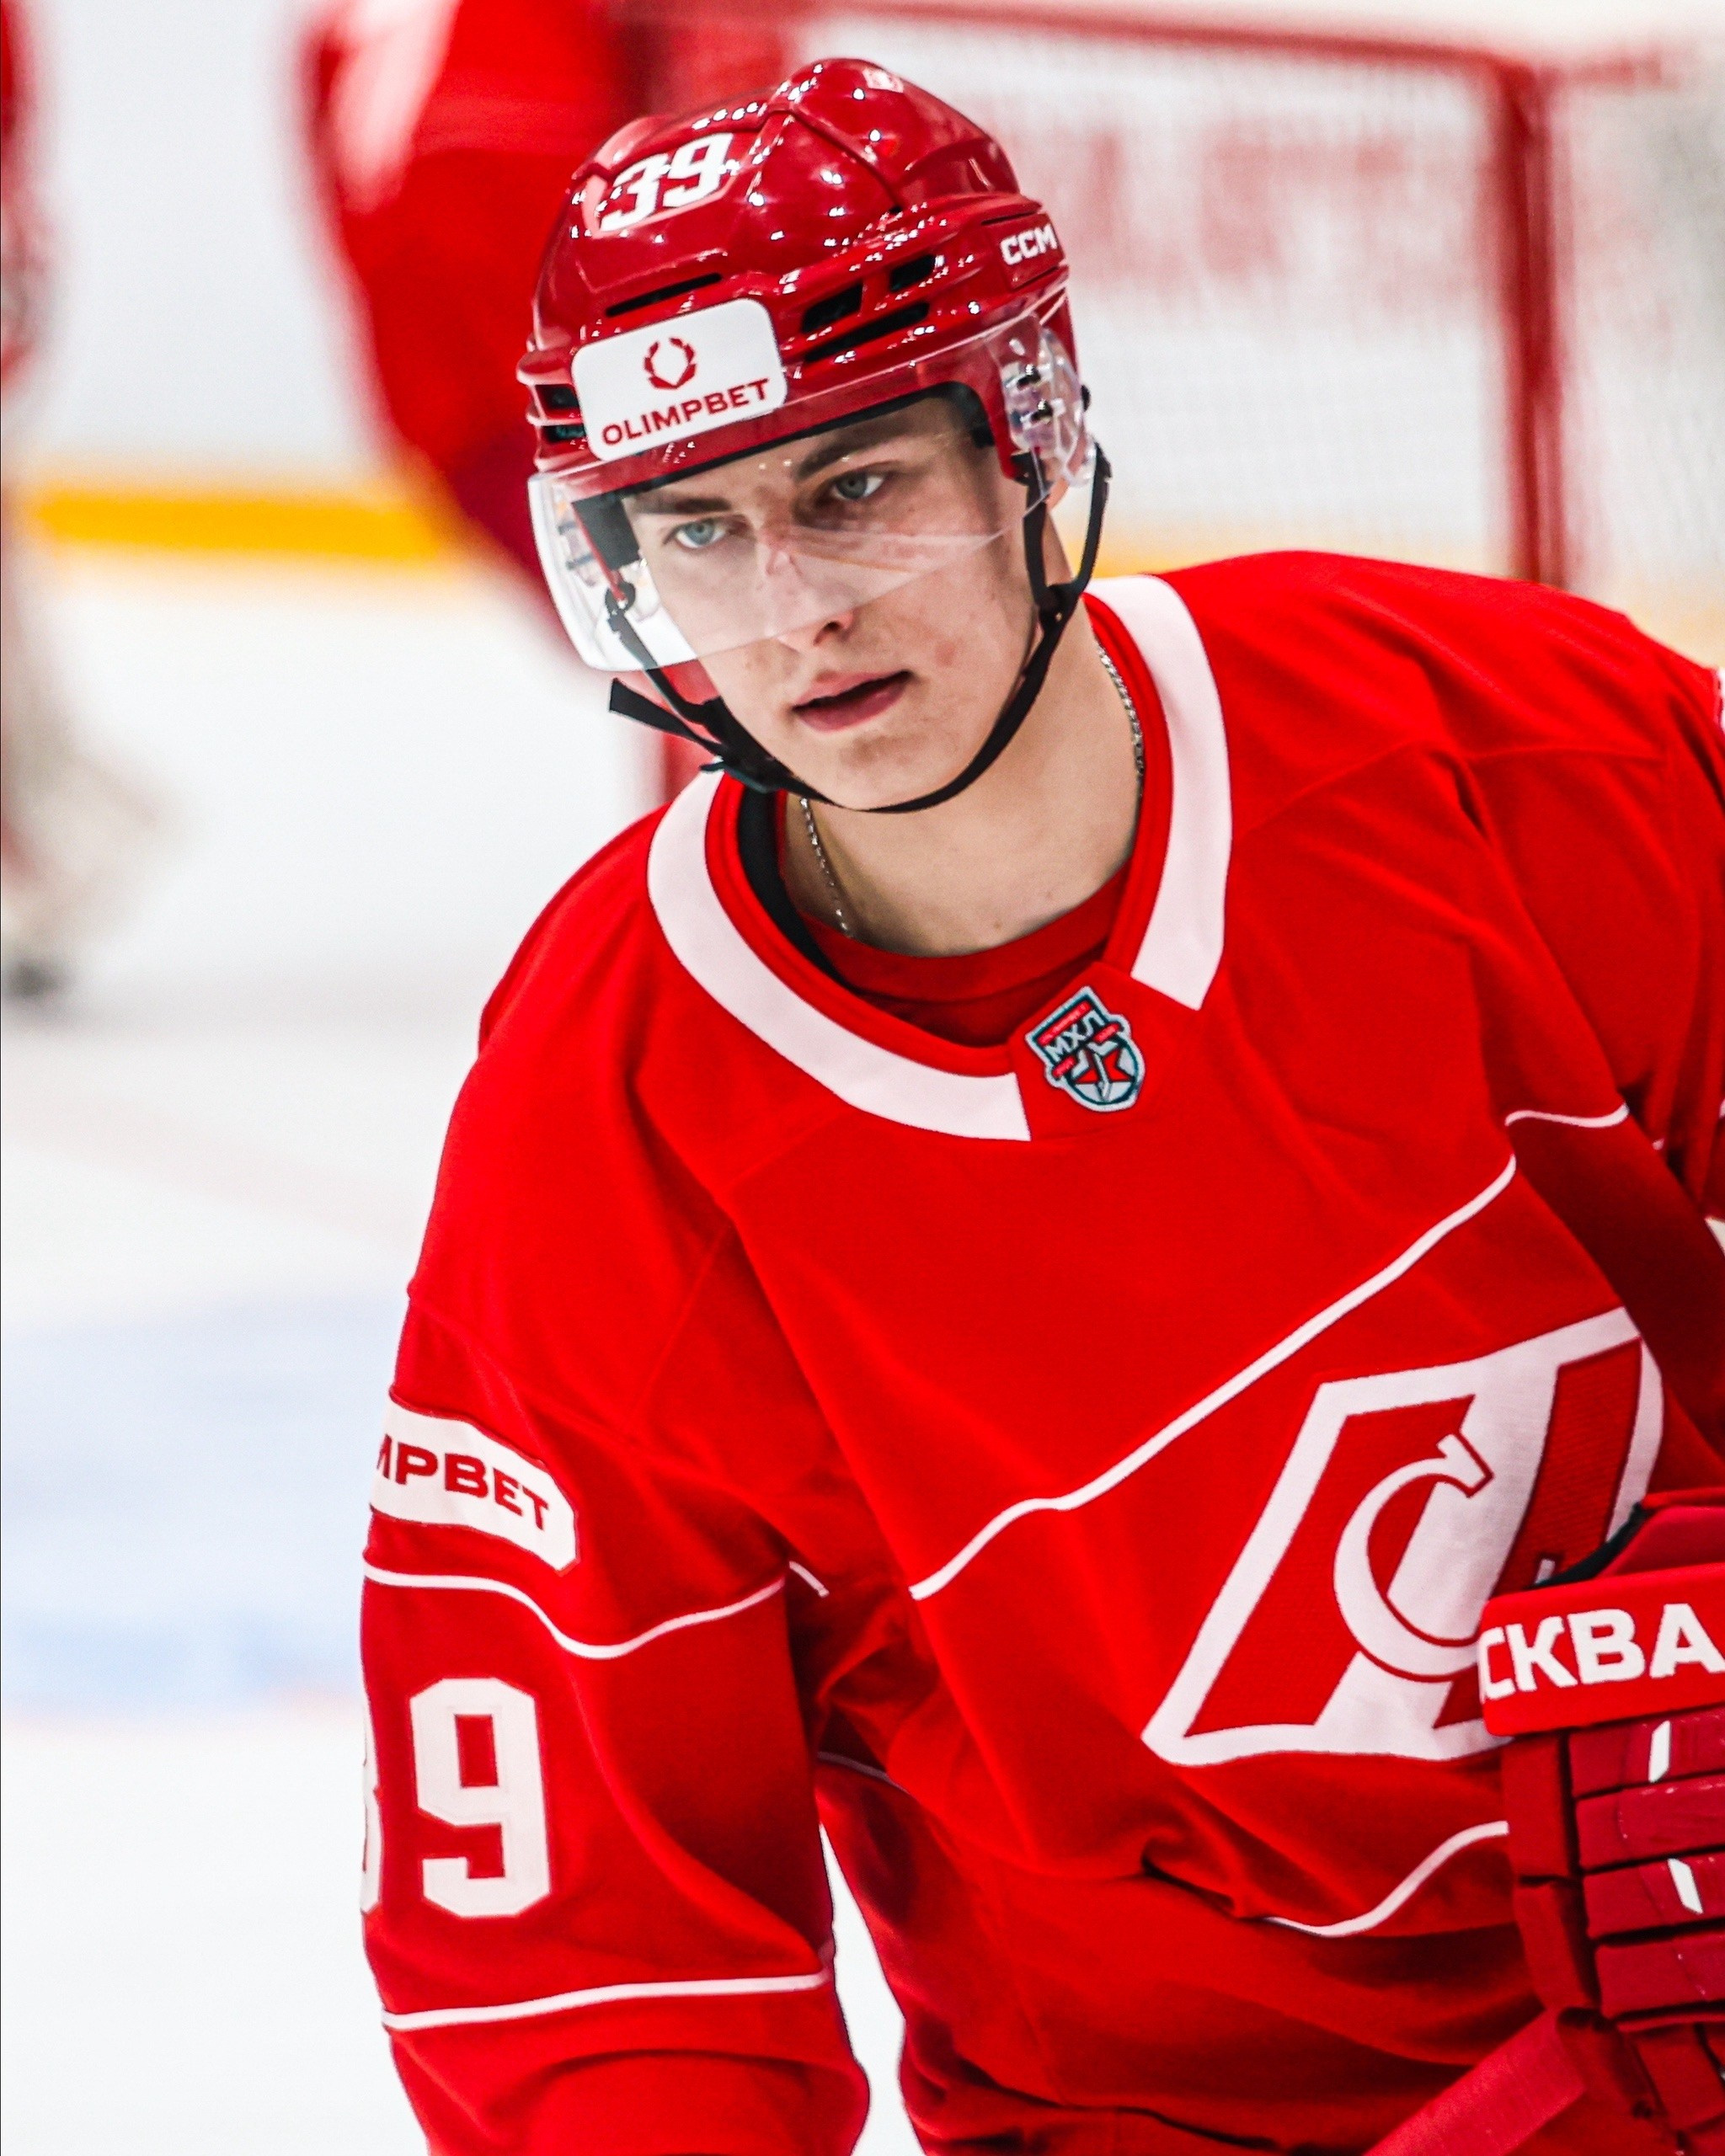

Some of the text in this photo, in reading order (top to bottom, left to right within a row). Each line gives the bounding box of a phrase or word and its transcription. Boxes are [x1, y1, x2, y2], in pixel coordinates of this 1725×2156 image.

[600, 133, 734, 232] 39
[1000, 223, 1058, 265] CCM
[602, 377, 769, 445] OLIMPBET
[1044, 1010, 1106, 1063] МХЛ
[361, 1677, 551, 1919] 9
